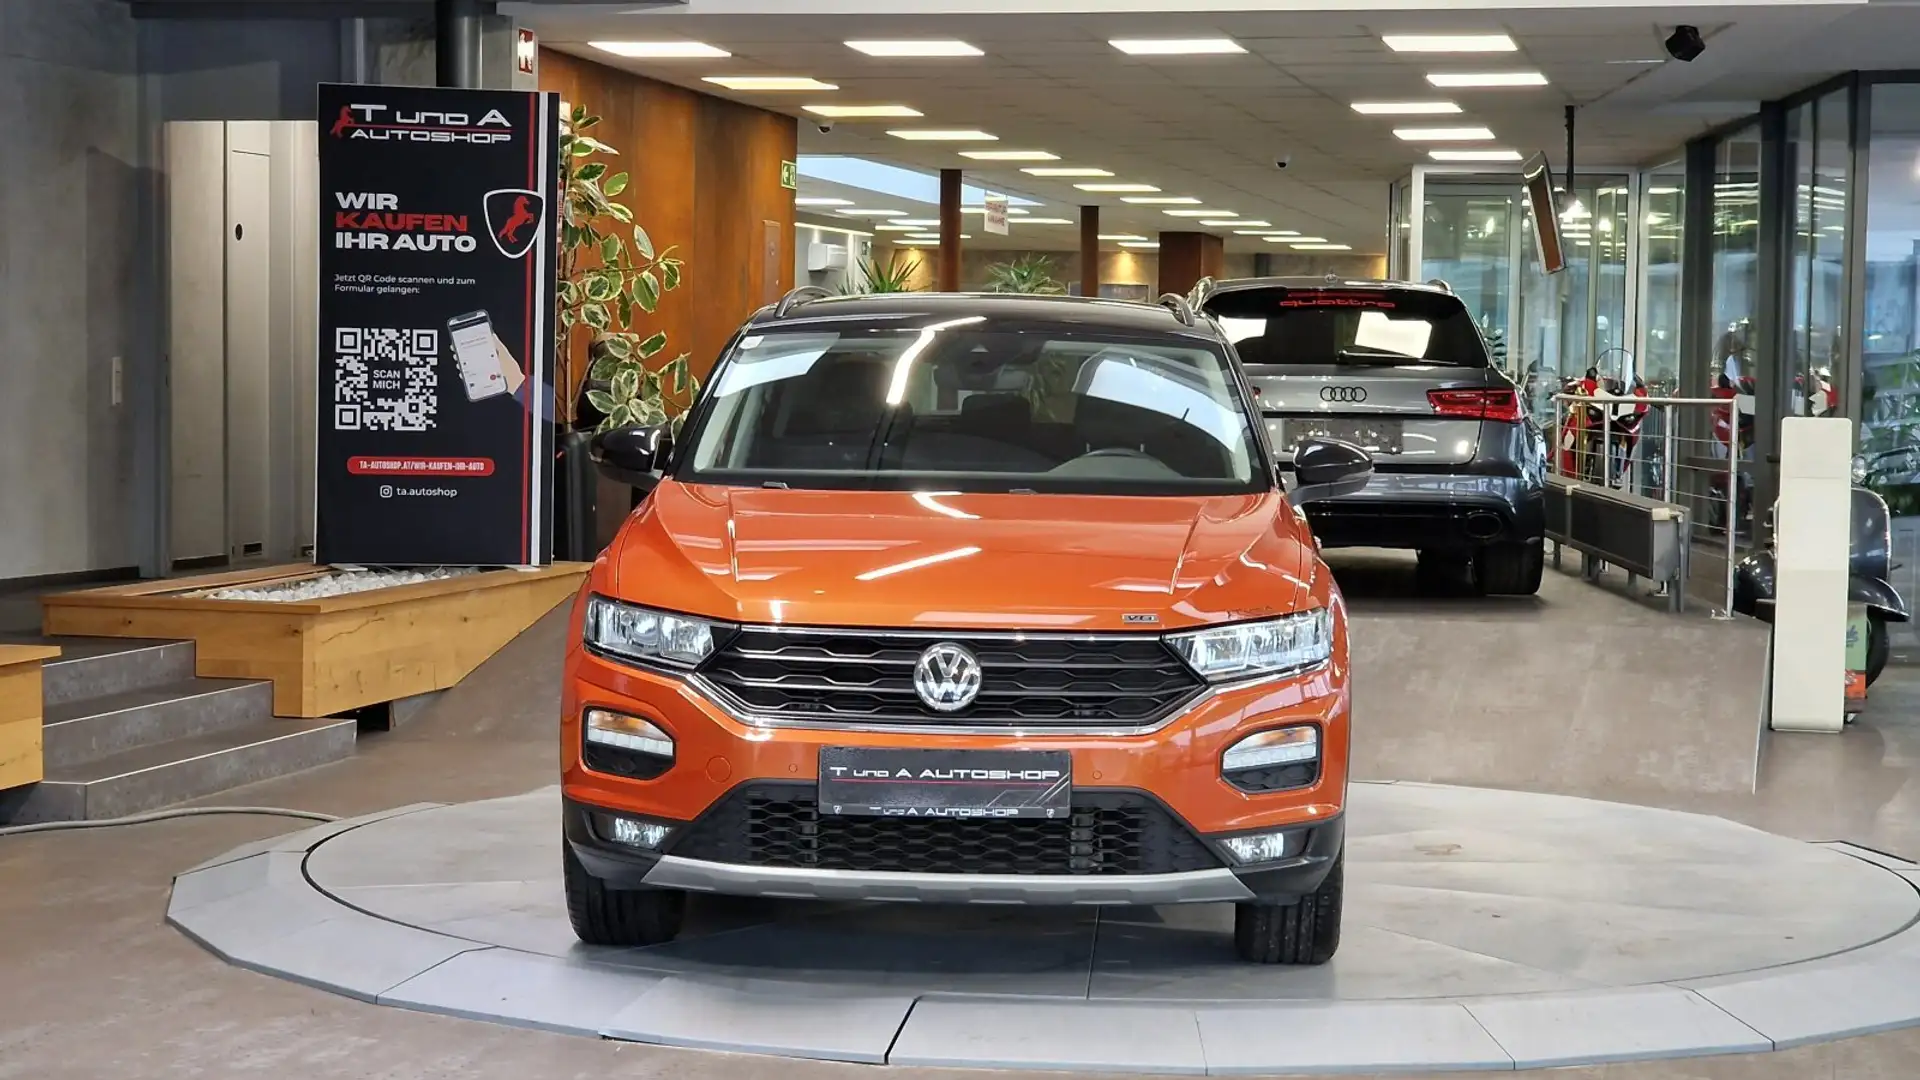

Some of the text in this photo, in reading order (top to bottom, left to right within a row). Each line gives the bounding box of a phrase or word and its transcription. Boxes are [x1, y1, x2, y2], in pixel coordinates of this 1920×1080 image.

[350, 103, 387, 122] T
[476, 109, 512, 127] A
[350, 128, 512, 144] AUTOSHOP
[335, 192, 398, 210] WIR
[335, 212, 468, 232] KAUFEN
[335, 232, 477, 253] IHR AUTO
[334, 273, 476, 285] Jetzt QR Code scannen und zum
[334, 283, 420, 296] Formular gelangen:
[1279, 298, 1396, 308] quattro
[372, 369, 401, 380] SCAN
[372, 380, 401, 390] MICH
[396, 487, 458, 498] ta.autoshop
[829, 766, 848, 777] T
[895, 768, 913, 778] A
[919, 769, 1060, 781] AUTOSHOP
[905, 806, 919, 816] A
[923, 807, 1020, 817] AUTOSHOP
